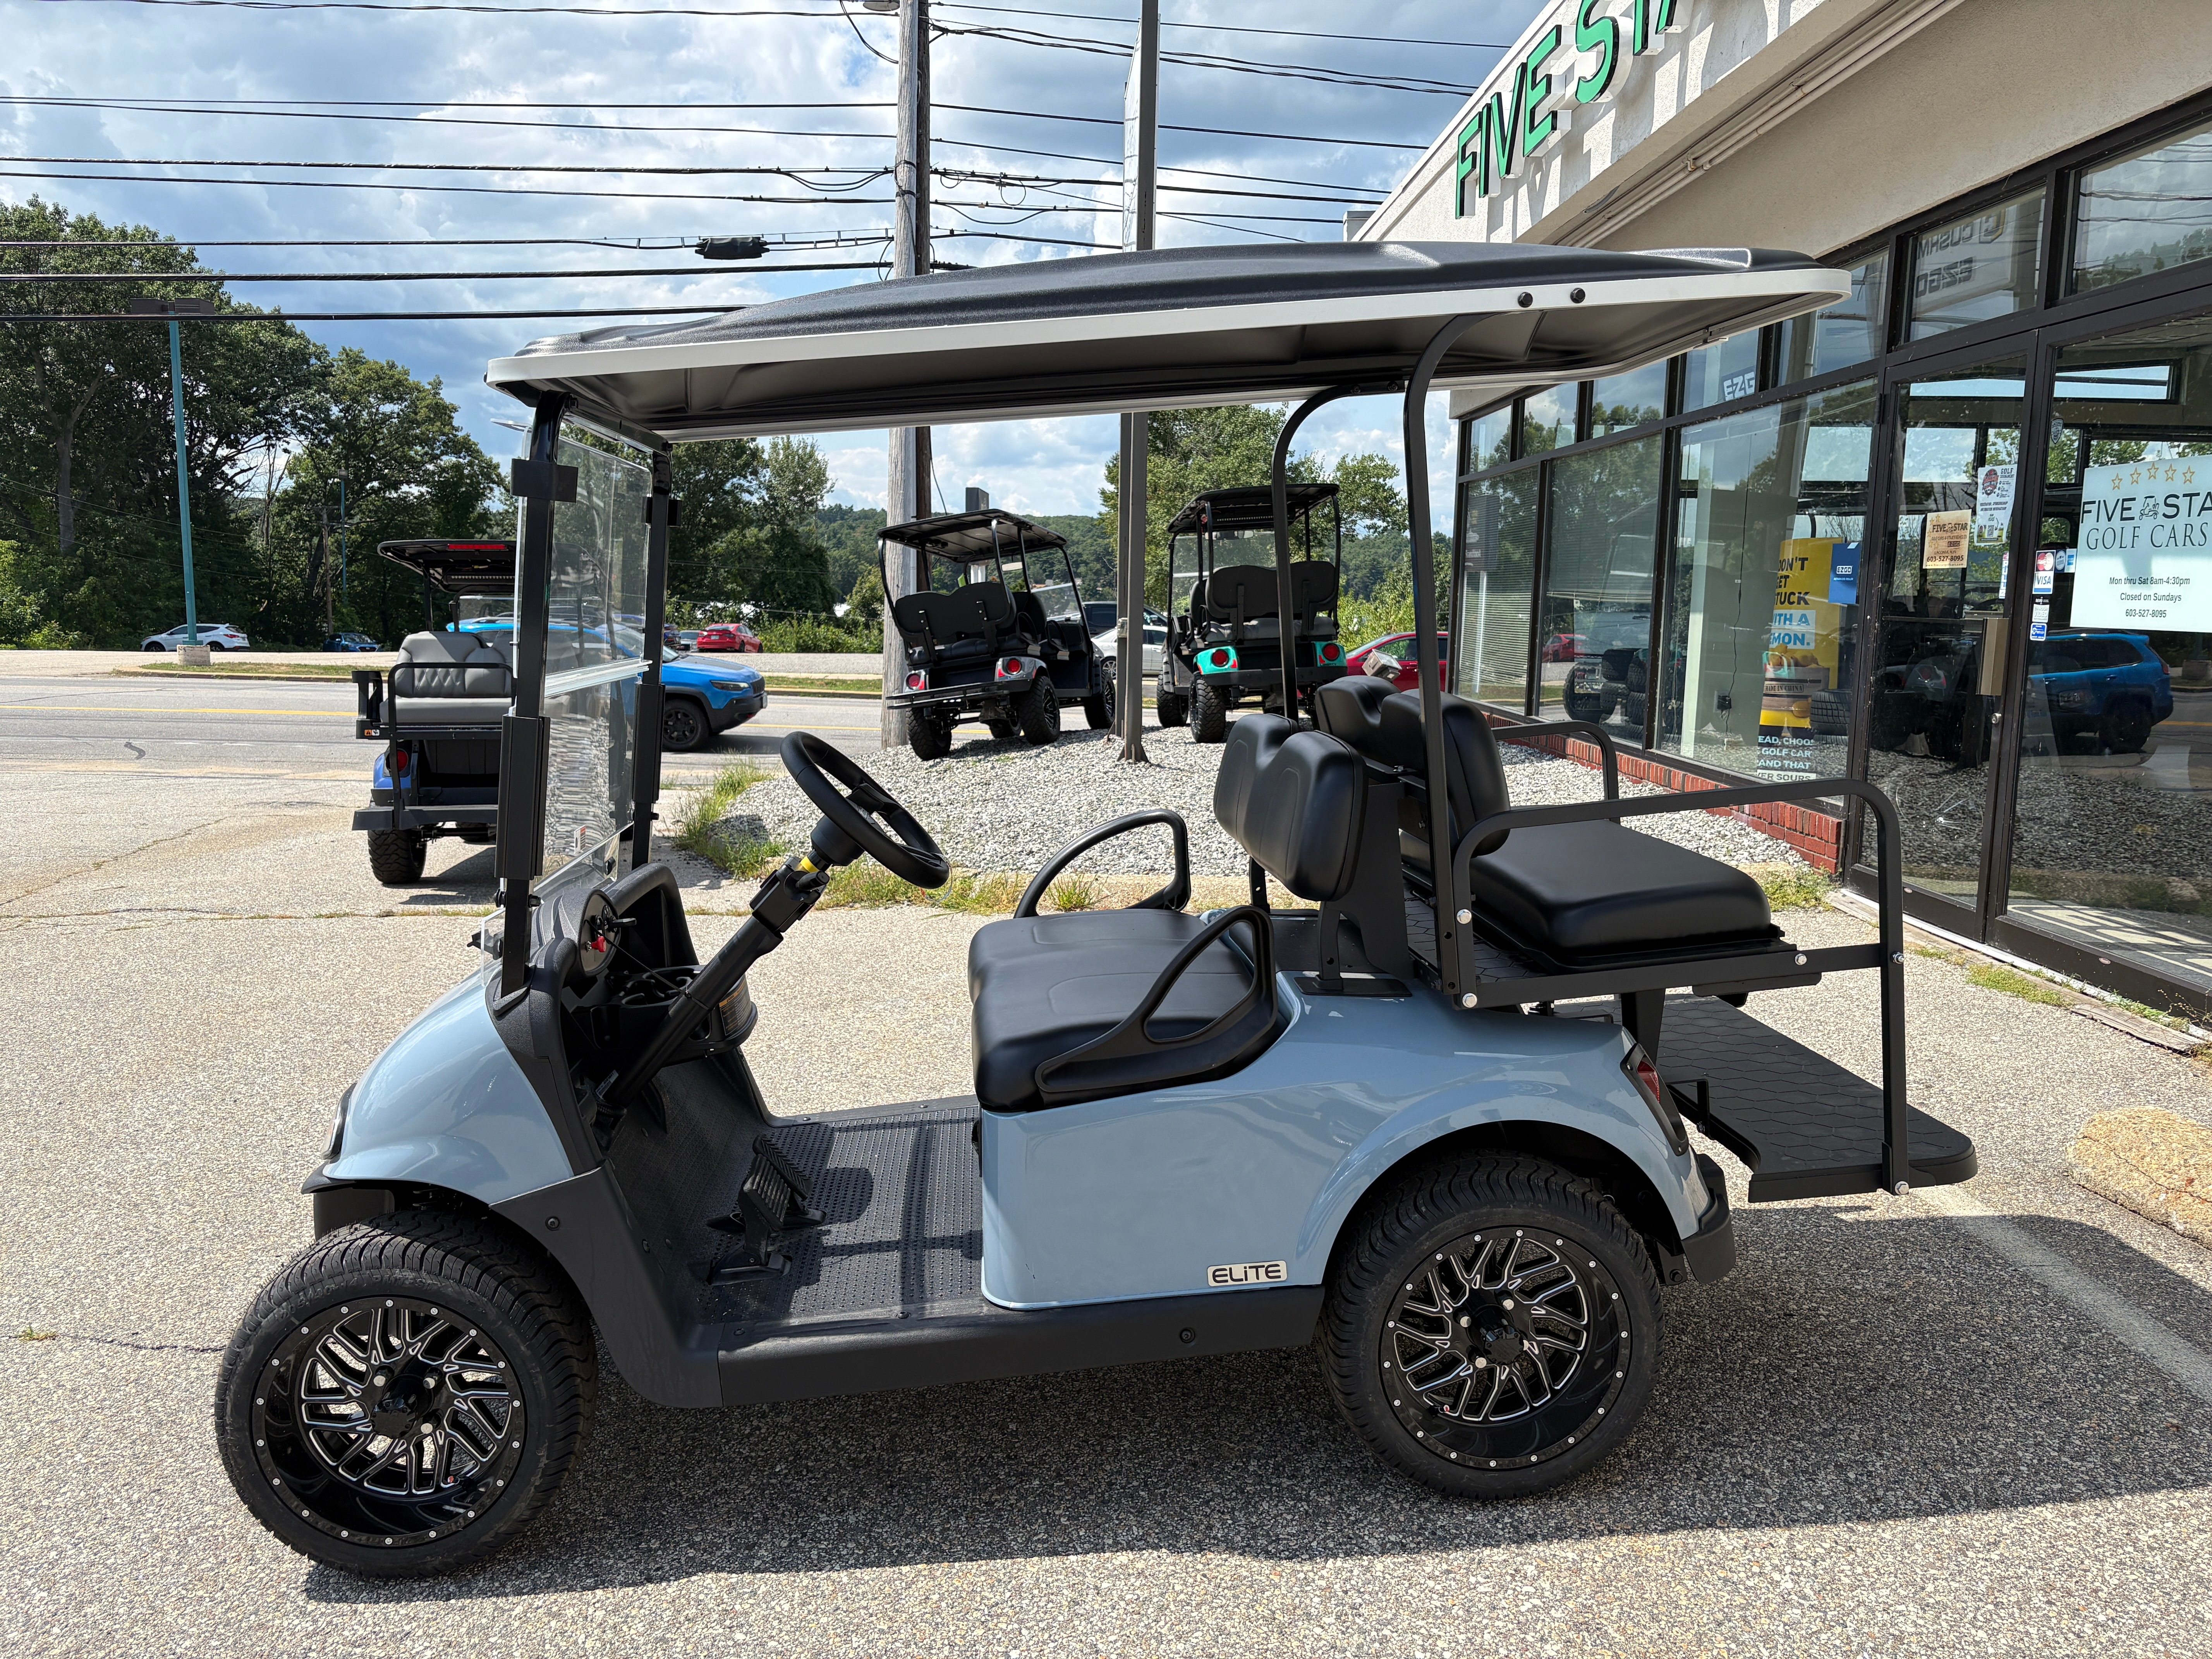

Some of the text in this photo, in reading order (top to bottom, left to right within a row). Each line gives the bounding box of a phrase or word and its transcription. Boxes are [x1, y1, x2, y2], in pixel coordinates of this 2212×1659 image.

[1456, 25, 1561, 219] FIVE
[2081, 497, 2136, 524] FIVE
[1932, 523, 1968, 532] FIVE STAR
[2086, 522, 2209, 550] GOLF CARS
[2037, 576, 2051, 585] VISA
[2109, 576, 2190, 586] Mon thru Sat 8am-4:30pm
[2120, 592, 2142, 601] Closed
[2153, 592, 2182, 603] Sundays
[2125, 609, 2167, 618] 603-527-8095
[1774, 613, 1810, 625] ITH A
[1762, 747, 1789, 756] GOLF
[1757, 759, 1811, 769] AND THAT
